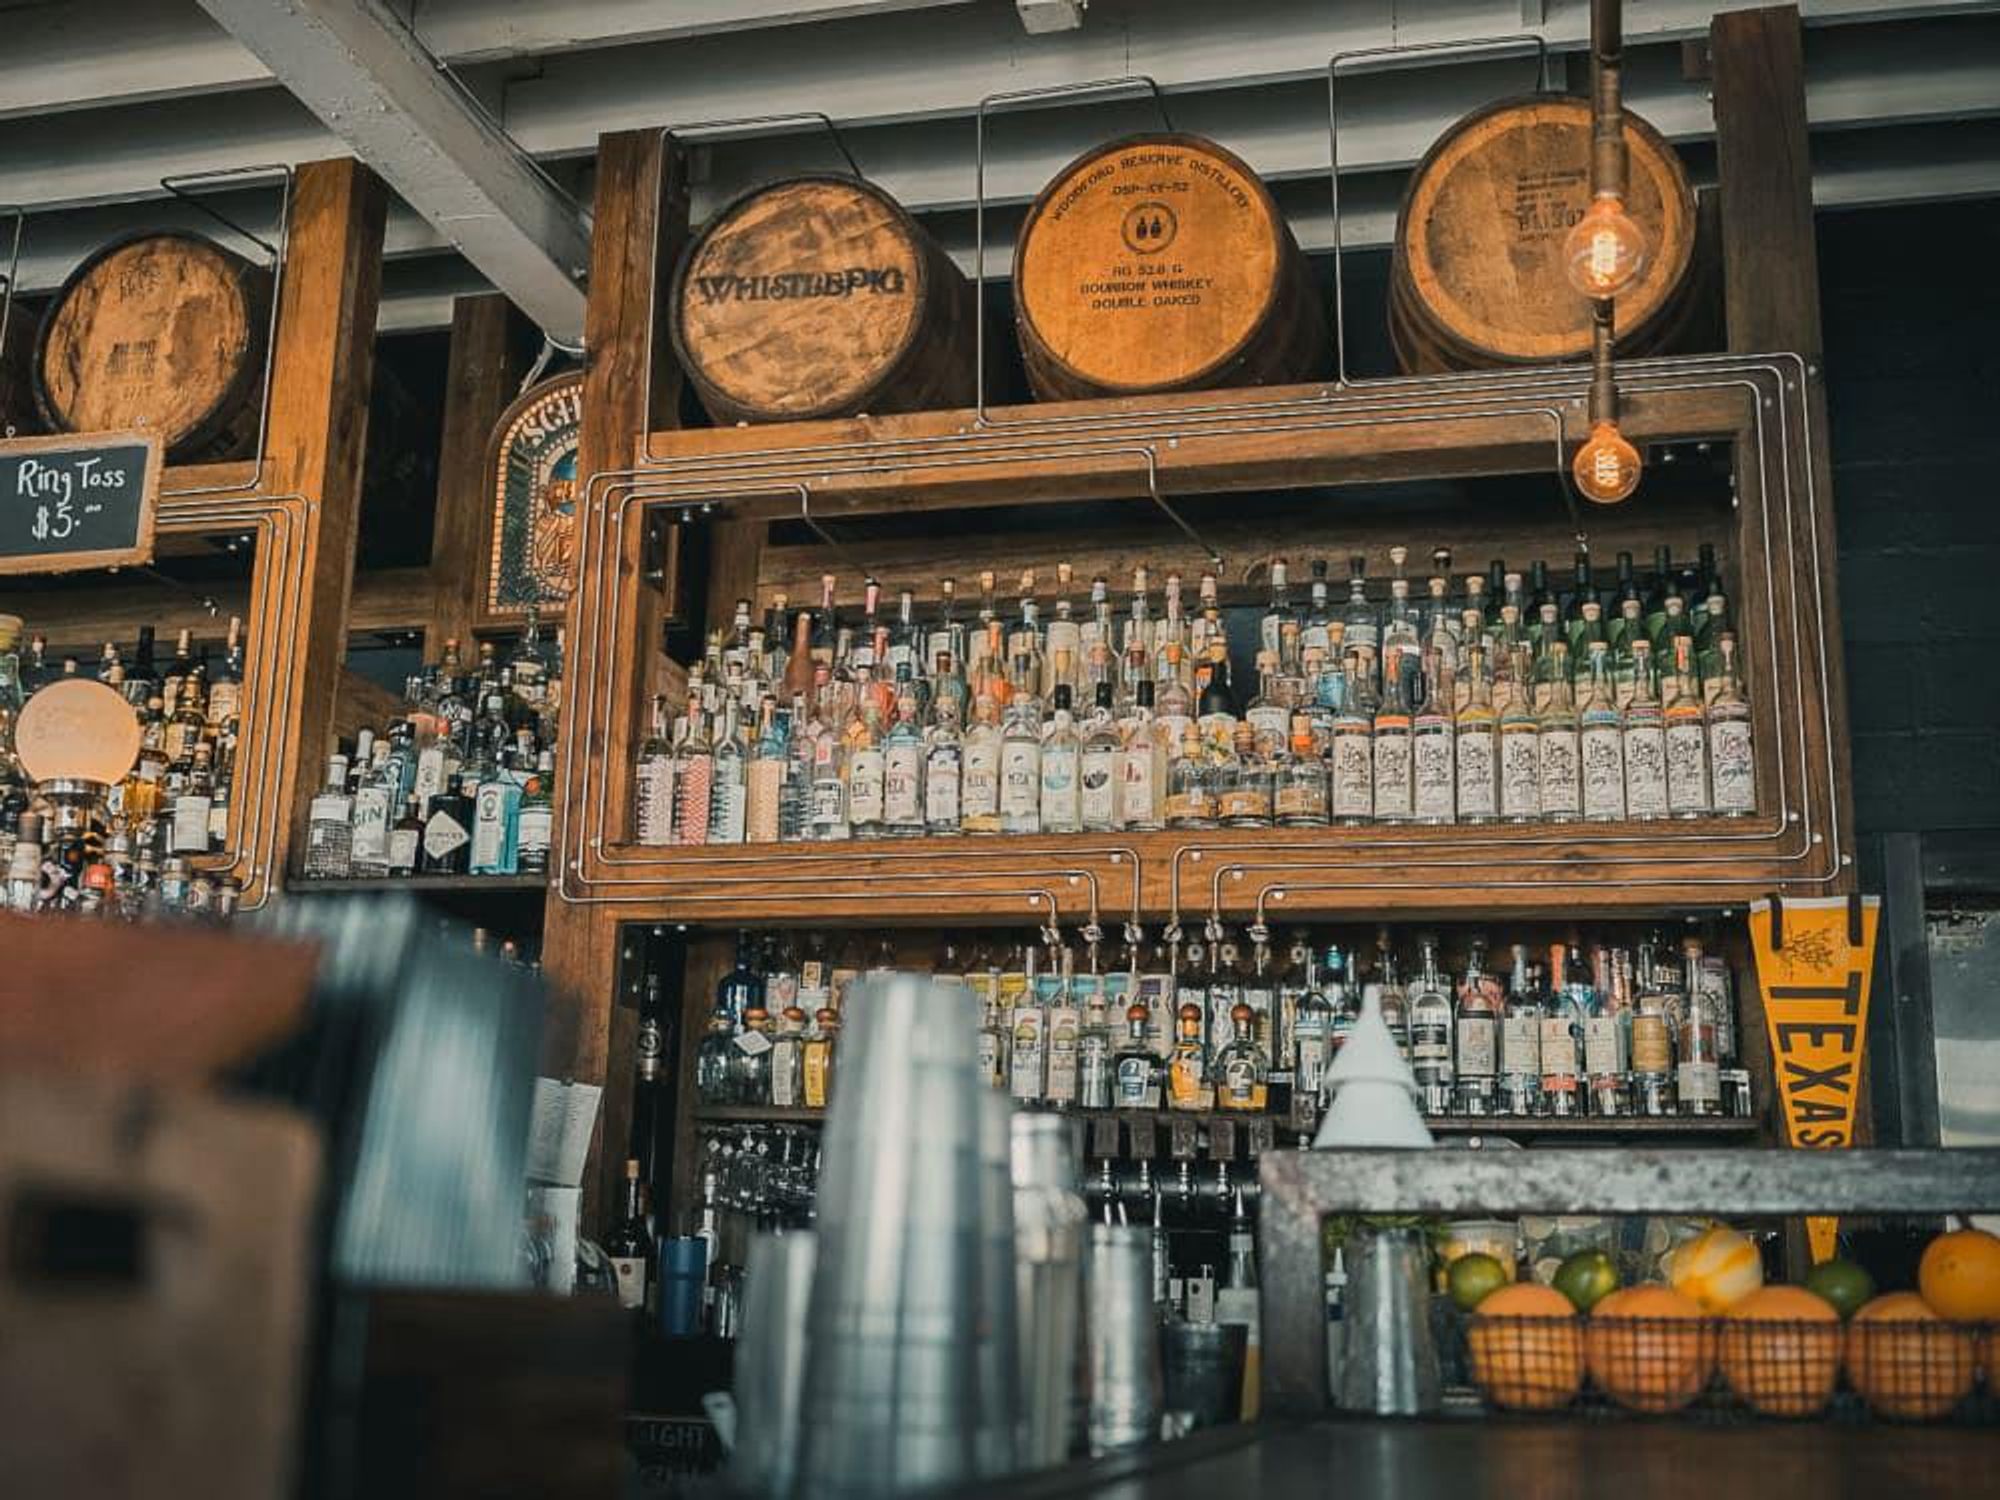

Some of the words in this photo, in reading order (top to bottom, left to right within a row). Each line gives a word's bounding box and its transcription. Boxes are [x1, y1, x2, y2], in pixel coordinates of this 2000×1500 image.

[1052, 164, 1115, 222] WOODFORD
[1120, 154, 1183, 170] RESERVE
[1080, 281, 1146, 295] BOURBON
[1151, 278, 1215, 291] WHISKEY
[1091, 298, 1147, 310] DOUBLE
[1152, 294, 1201, 307] OAKED
[17, 459, 72, 507] Ring
[74, 456, 126, 490] Toss
[1769, 970, 1863, 1148] TEXAS
